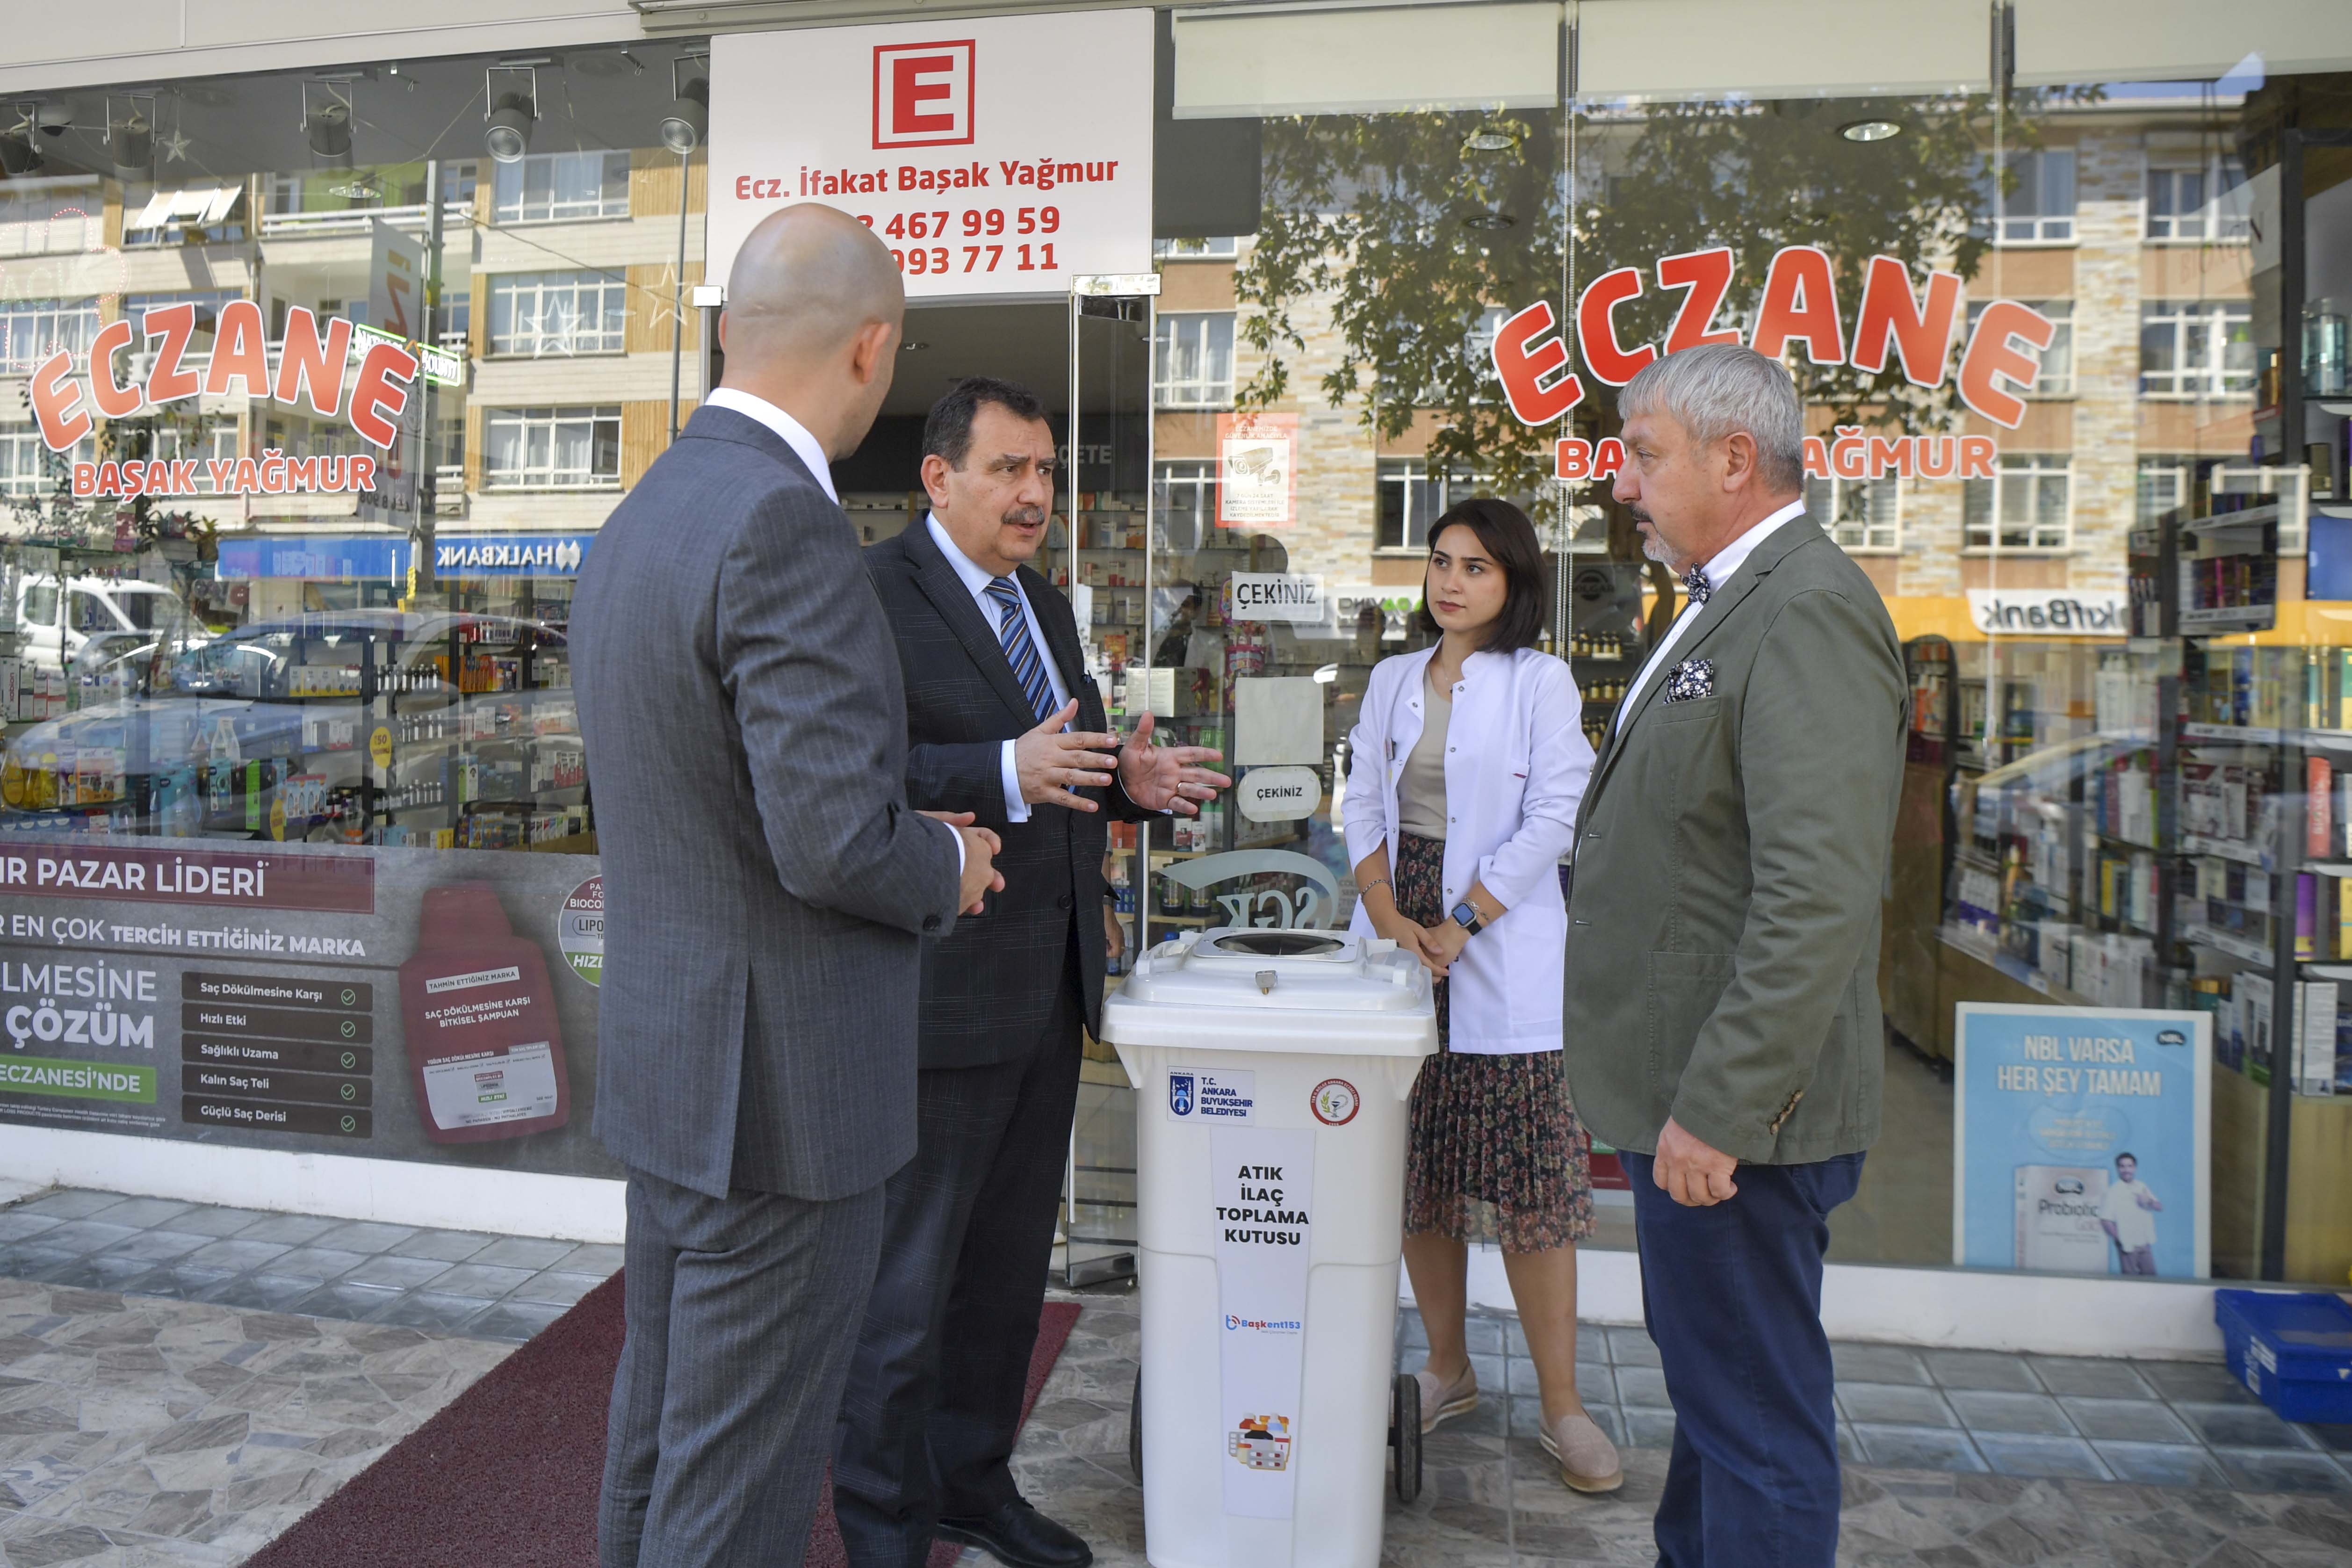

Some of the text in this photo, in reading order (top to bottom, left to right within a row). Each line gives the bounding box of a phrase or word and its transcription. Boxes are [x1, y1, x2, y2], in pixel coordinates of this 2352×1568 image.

[893, 55, 953, 134] E
[736, 158, 1119, 200] Ecz. İfakat Başak Yağmur
[885, 211, 949, 239] 467
[962, 208, 1004, 237] 99
[1017, 206, 1060, 234] 59
[963, 245, 1003, 273] 77
[1017, 243, 1058, 270] 11
[1491, 245, 2056, 430] ECZANE
[422, 349, 457, 379] BOUNTY
[30, 299, 419, 453] ECZANE
[1055, 445, 1111, 469] ÇETE
[1803, 426, 1997, 480] AĞMUR
[72, 448, 376, 504] BAŞAK YAĞMUR
[1237, 579, 1316, 609] ÇEKİNİZ
[1570, 584, 1615, 593] OLGAR
[1256, 785, 1303, 800] ÇEKİNİZ
[38, 859, 145, 890] PAZAR
[570, 898, 604, 909] BIOCO
[579, 919, 604, 932] LIPO
[13, 914, 43, 938] EN
[52, 917, 104, 945] ÇOK
[111, 923, 181, 946] TERCİH
[188, 926, 284, 952] ETTİĞİNİZ
[289, 937, 366, 957] MARKA
[573, 954, 603, 968] HIZL
[3, 960, 157, 1001] LMESİNE
[429, 971, 516, 990] TAHMİN ETTİĞİNİZ MARKA
[201, 983, 322, 1002] Saç Dökülmesine Karşı
[425, 996, 531, 1019] SAÇ DÖKÜLMESİNE KARŞI
[6, 997, 153, 1049] ÇÖZÜM
[200, 1013, 246, 1026] Hızlı Etki
[440, 1009, 519, 1028] BİTKİSEL ŞAMPUAN
[2159, 1033, 2184, 1044] NBL
[201, 1044, 279, 1060] Sağlıklı Uzama
[451, 1053, 480, 1062] DÖKÜLMESİNE
[2024, 1034, 2136, 1064] NBL VARSA
[201, 1074, 269, 1090] Kalın Saç Teli
[1201, 1077, 1217, 1085] T.C.
[1997, 1065, 2162, 1097] HER ŞEY TAMAM
[1201, 1087, 1236, 1096] ANKARA
[201, 1106, 286, 1122] Güçlü Saç Derisi
[1238, 1166, 1283, 1181] ATIK
[1241, 1184, 1284, 1207] İLAÇ
[1216, 1207, 1309, 1225] TOPLAMA
[1225, 1229, 1301, 1245] KUTUSU
[1241, 1320, 1301, 1330] Başkent153
